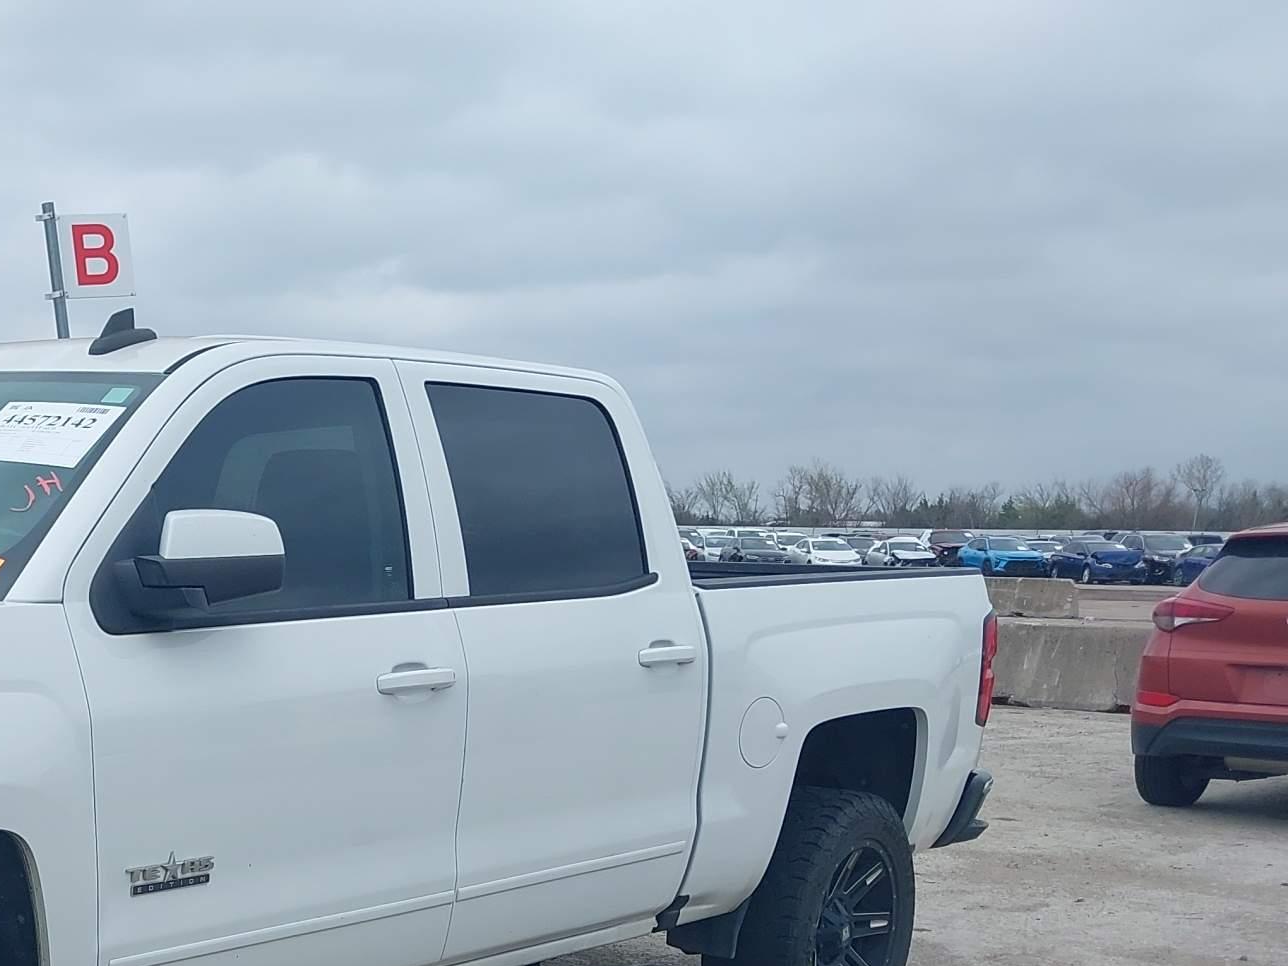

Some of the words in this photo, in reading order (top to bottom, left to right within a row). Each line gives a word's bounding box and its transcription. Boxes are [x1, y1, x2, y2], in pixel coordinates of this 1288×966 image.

[71, 222, 121, 287] B
[3, 413, 98, 429] 44572142
[136, 875, 207, 894] EDITION
